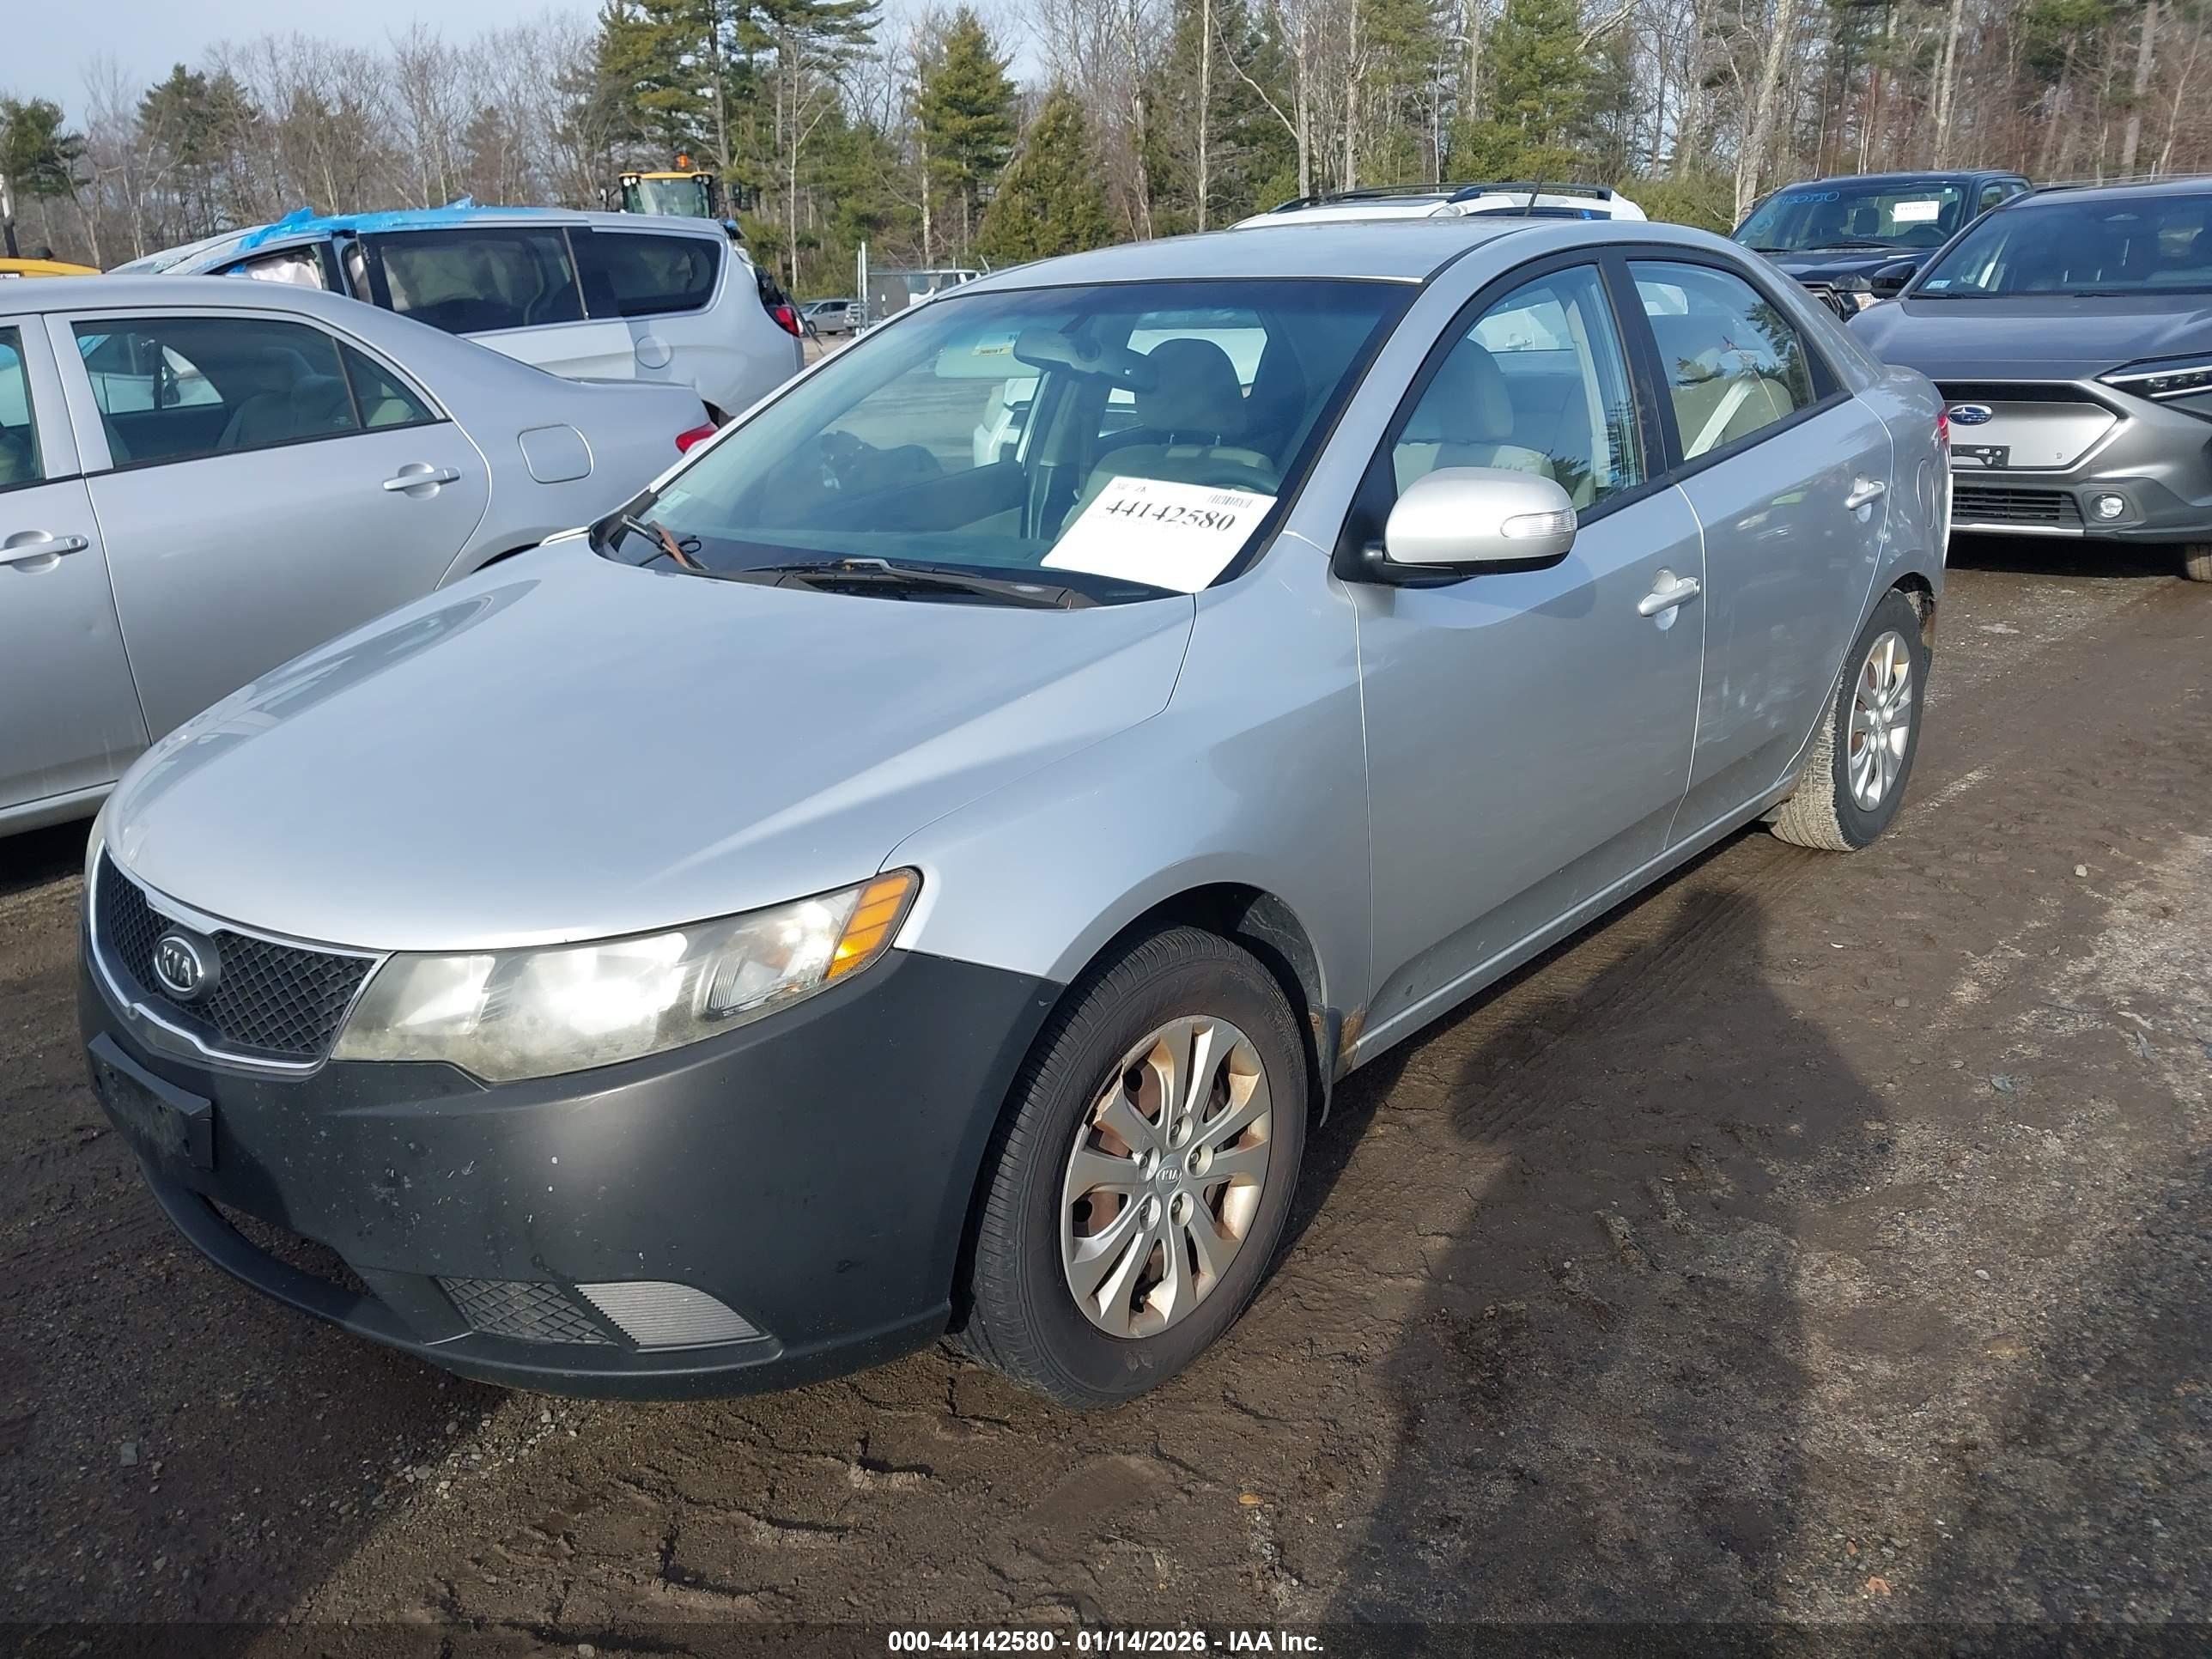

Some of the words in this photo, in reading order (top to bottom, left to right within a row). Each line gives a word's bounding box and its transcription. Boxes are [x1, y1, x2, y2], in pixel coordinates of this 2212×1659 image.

[1106, 499, 1236, 532] 44142580
[163, 945, 191, 986] KIA
[1161, 1169, 1180, 1181] KIA
